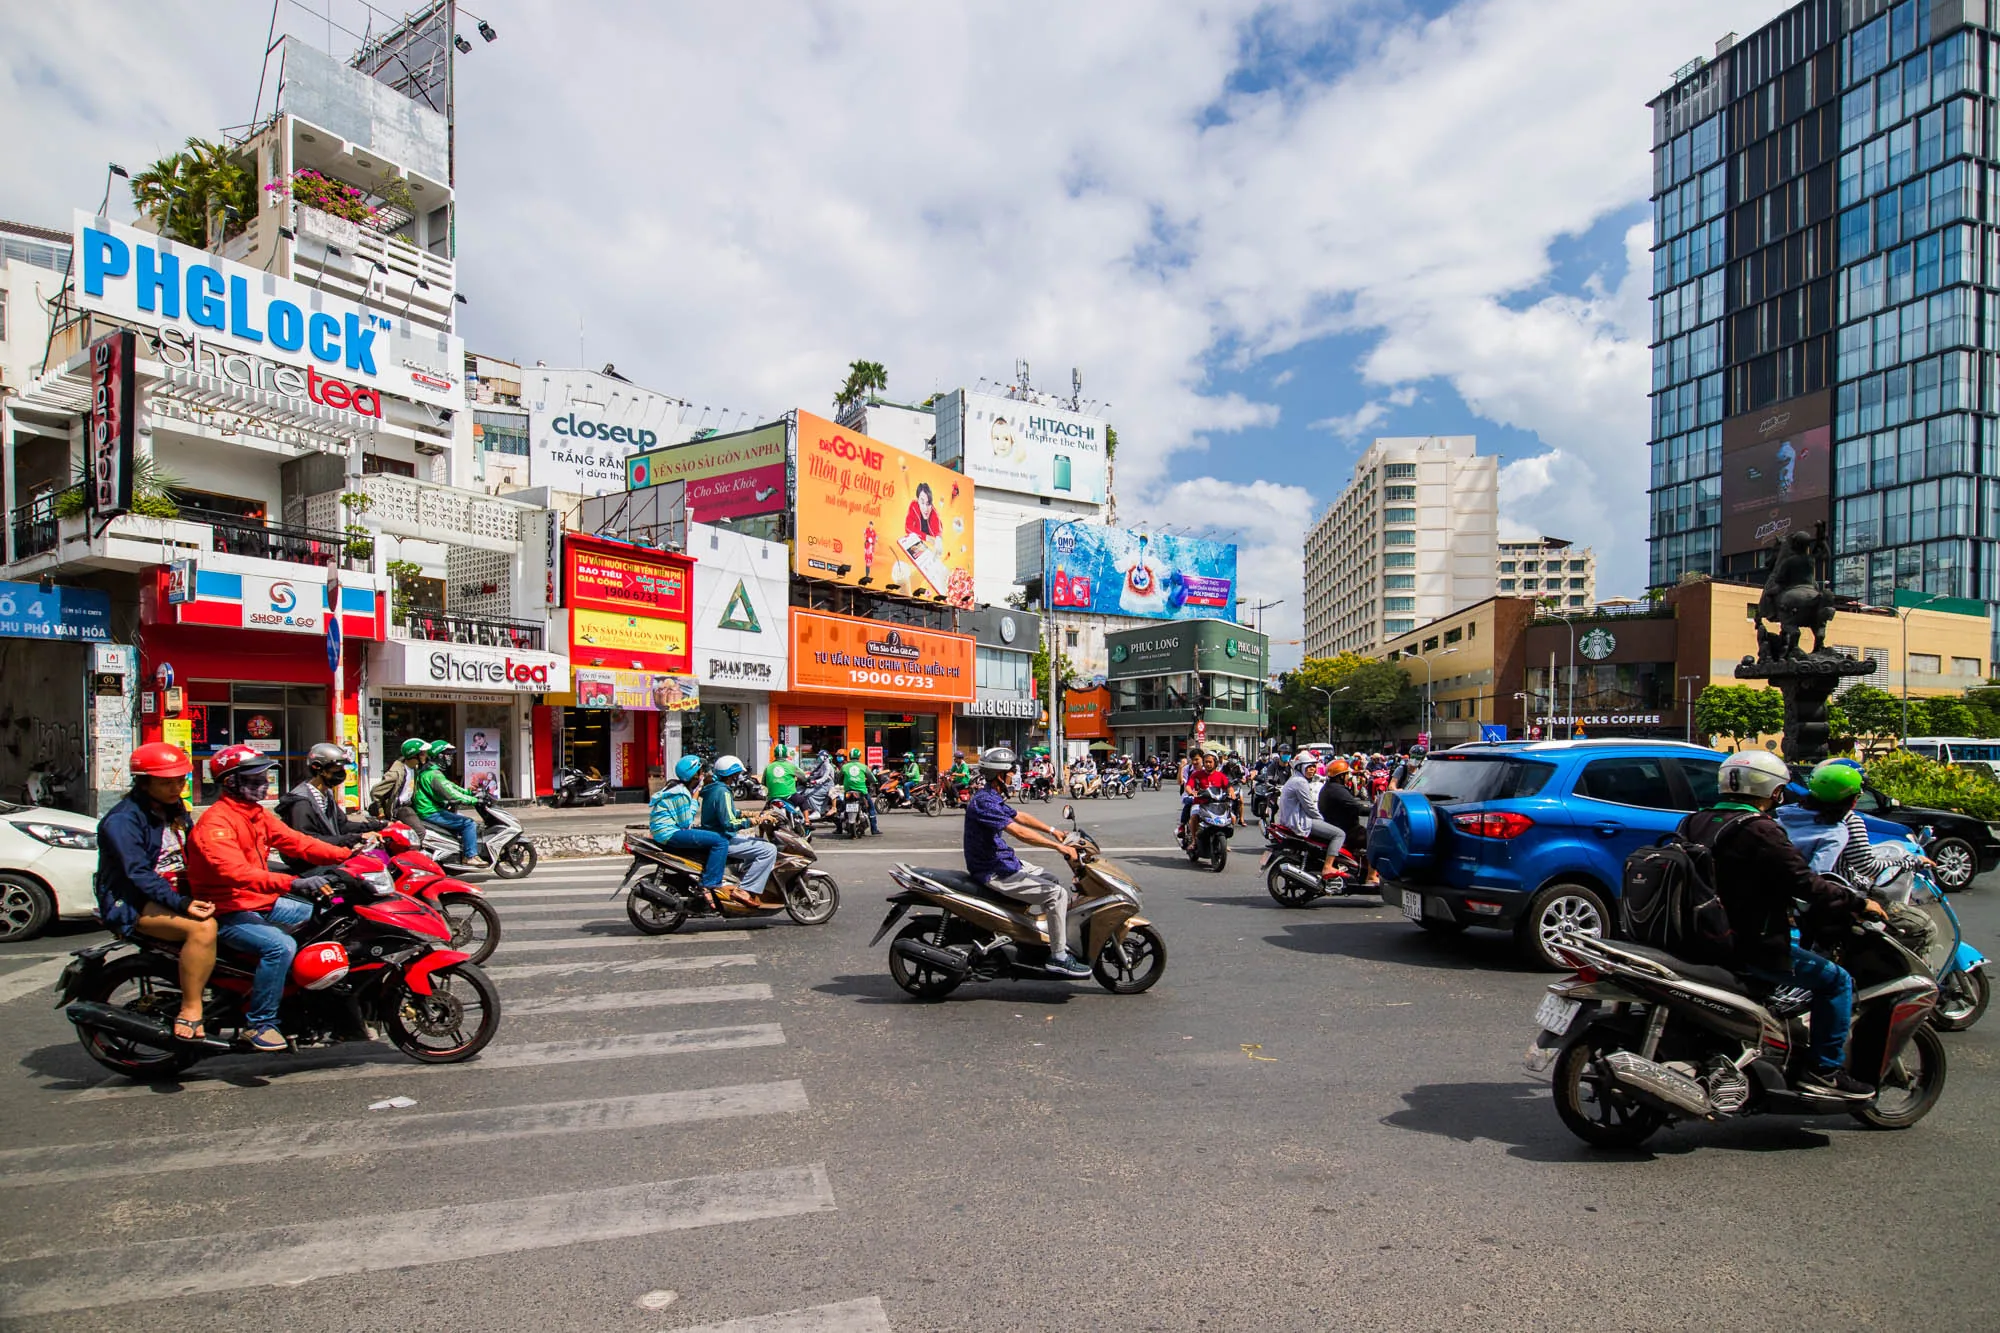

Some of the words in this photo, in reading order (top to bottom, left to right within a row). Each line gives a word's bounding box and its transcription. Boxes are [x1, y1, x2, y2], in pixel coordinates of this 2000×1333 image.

[83, 227, 377, 376] PHGLOCK
[156, 322, 381, 418] Sharetea
[96, 343, 112, 505] Sharetea
[552, 412, 657, 453] closeup
[1030, 416, 1094, 440] HITACHI
[1025, 430, 1058, 445] Inspire
[1060, 438, 1076, 448] the
[1077, 440, 1098, 452] Next
[551, 449, 594, 465] TRẮNG
[599, 456, 625, 469] RĂN
[653, 464, 673, 479] YẾN
[676, 459, 695, 473] SÀO
[698, 453, 715, 469] SÀI
[717, 449, 741, 465] GÒN
[743, 442, 781, 461] ANPHA
[587, 469, 607, 479] dừa
[809, 453, 837, 483] Món
[854, 472, 882, 505] cũng
[882, 480, 895, 498] có
[694, 485, 712, 499] Cho
[714, 480, 731, 496] Sức
[1058, 537, 1074, 548] OMO
[577, 554, 587, 564] TƯ
[589, 556, 604, 566] VẤN
[605, 559, 621, 570] NUÔI
[623, 563, 640, 574] CHIM
[640, 565, 653, 576] YẾN
[670, 570, 681, 580] PHÍ
[579, 566, 598, 575] BAO
[600, 568, 622, 579] TIÊU
[170, 570, 183, 591] 24
[578, 575, 595, 583] GIA
[597, 577, 623, 588] CÔNG
[636, 575, 654, 585] SẢN
[604, 586, 630, 599] 1900
[633, 592, 659, 603] 6733
[24, 620, 51, 635] PHỐ
[53, 623, 78, 636] VĂN
[81, 625, 106, 638] HÓA
[251, 613, 283, 625] SHOP
[285, 615, 294, 625] &
[295, 617, 315, 628] GO
[581, 623, 599, 633] YẾN
[600, 625, 618, 636] SÀO
[654, 632, 680, 643] ANPHA
[1131, 641, 1153, 654] PHUC
[1155, 637, 1179, 650] LONG
[1238, 641, 1251, 654] PHUC
[430, 652, 548, 683] Sharetea
[831, 650, 850, 666] VẤN
[853, 653, 876, 669] NUÔI
[878, 660, 901, 672] CHIM
[924, 661, 945, 676] MIỄN
[947, 665, 960, 678] PHÍ
[644, 675, 652, 688] 2
[849, 670, 891, 685] 1900
[894, 675, 934, 689] 6733
[389, 691, 413, 699] SHARE
[970, 699, 994, 716] Mr.8
[996, 700, 1034, 717] COFFEE
[1535, 715, 1609, 725] STARBCKS
[1610, 715, 1660, 725] COFFEE
[1669, 989, 1691, 1000] AIR
[1693, 997, 1735, 1015] BLADE
